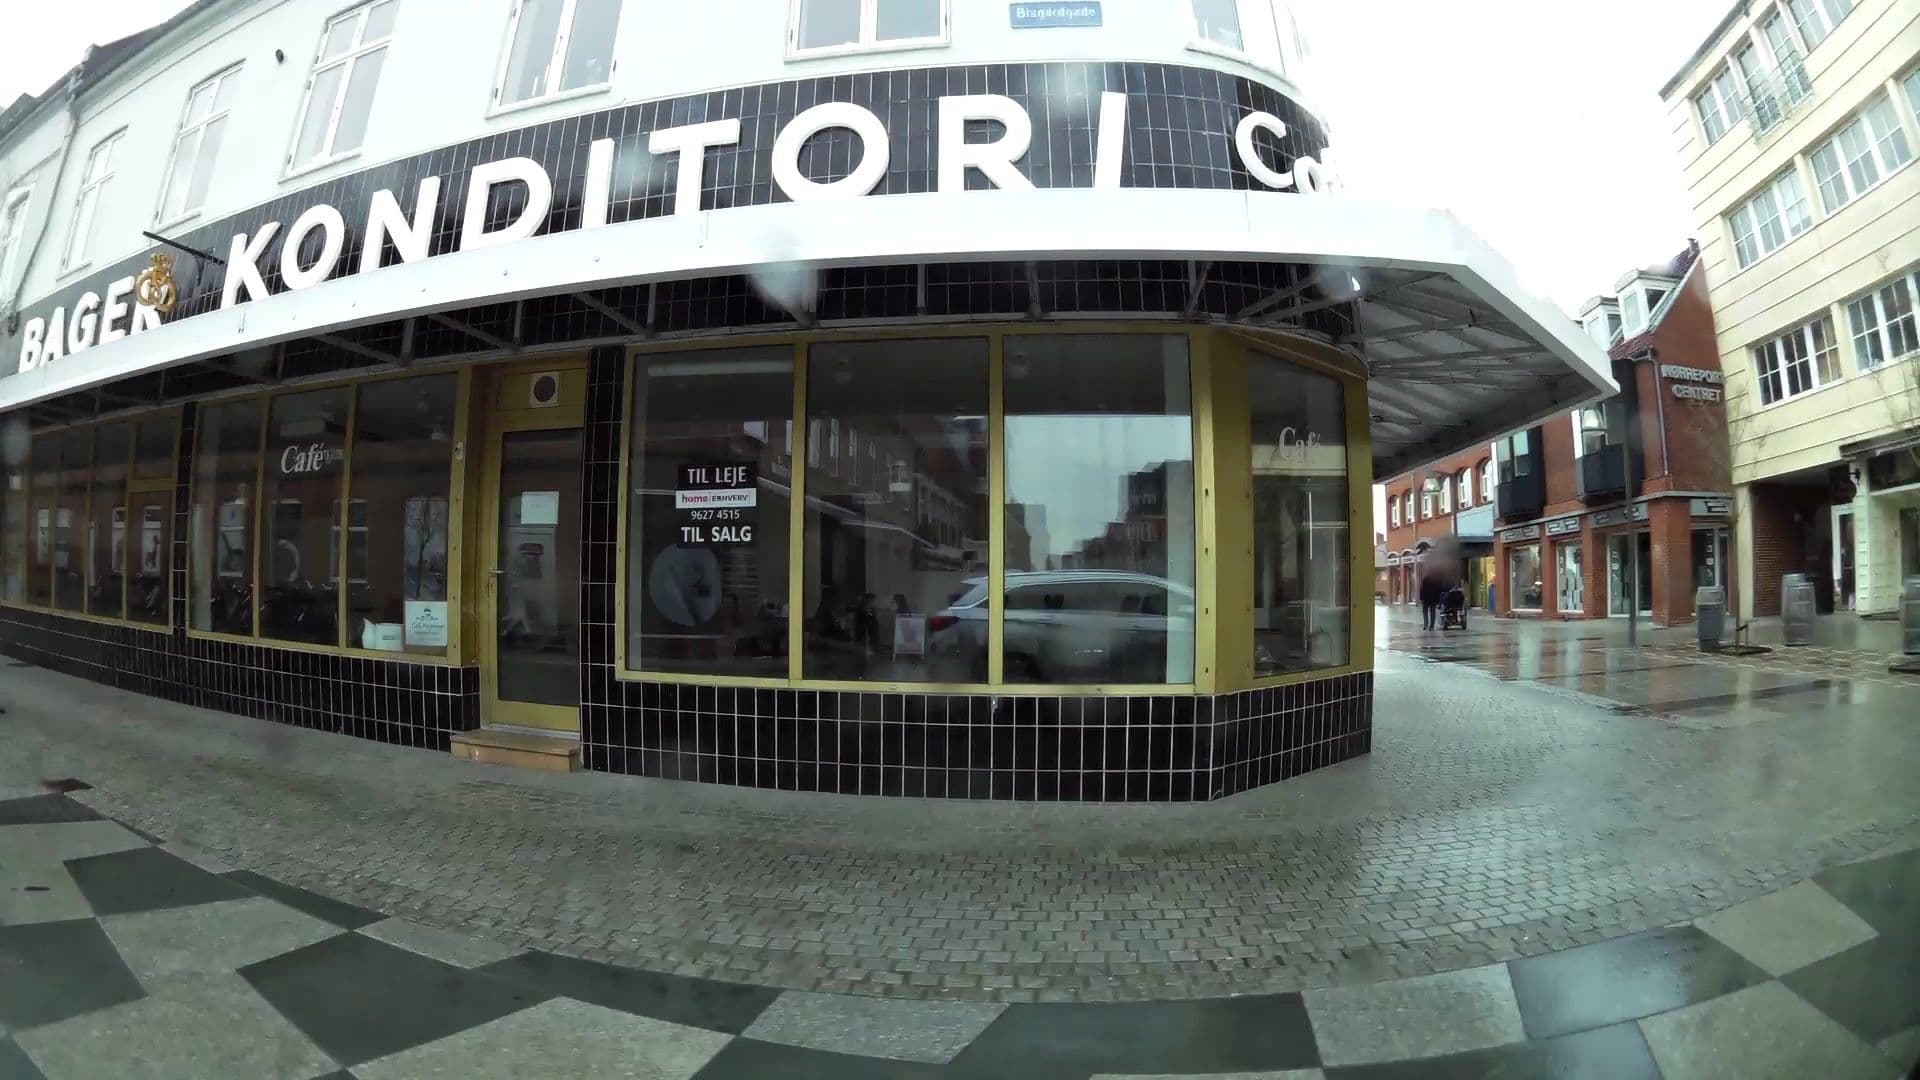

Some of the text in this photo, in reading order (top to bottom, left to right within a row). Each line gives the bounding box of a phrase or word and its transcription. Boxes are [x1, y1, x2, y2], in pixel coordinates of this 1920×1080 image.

[219, 91, 1128, 310] KONDITORI
[281, 442, 325, 474] Café
[687, 466, 747, 487] TIL LEJE
[681, 492, 708, 503] home
[690, 509, 740, 520] 9627 4515
[680, 525, 752, 543] TIL SALG
